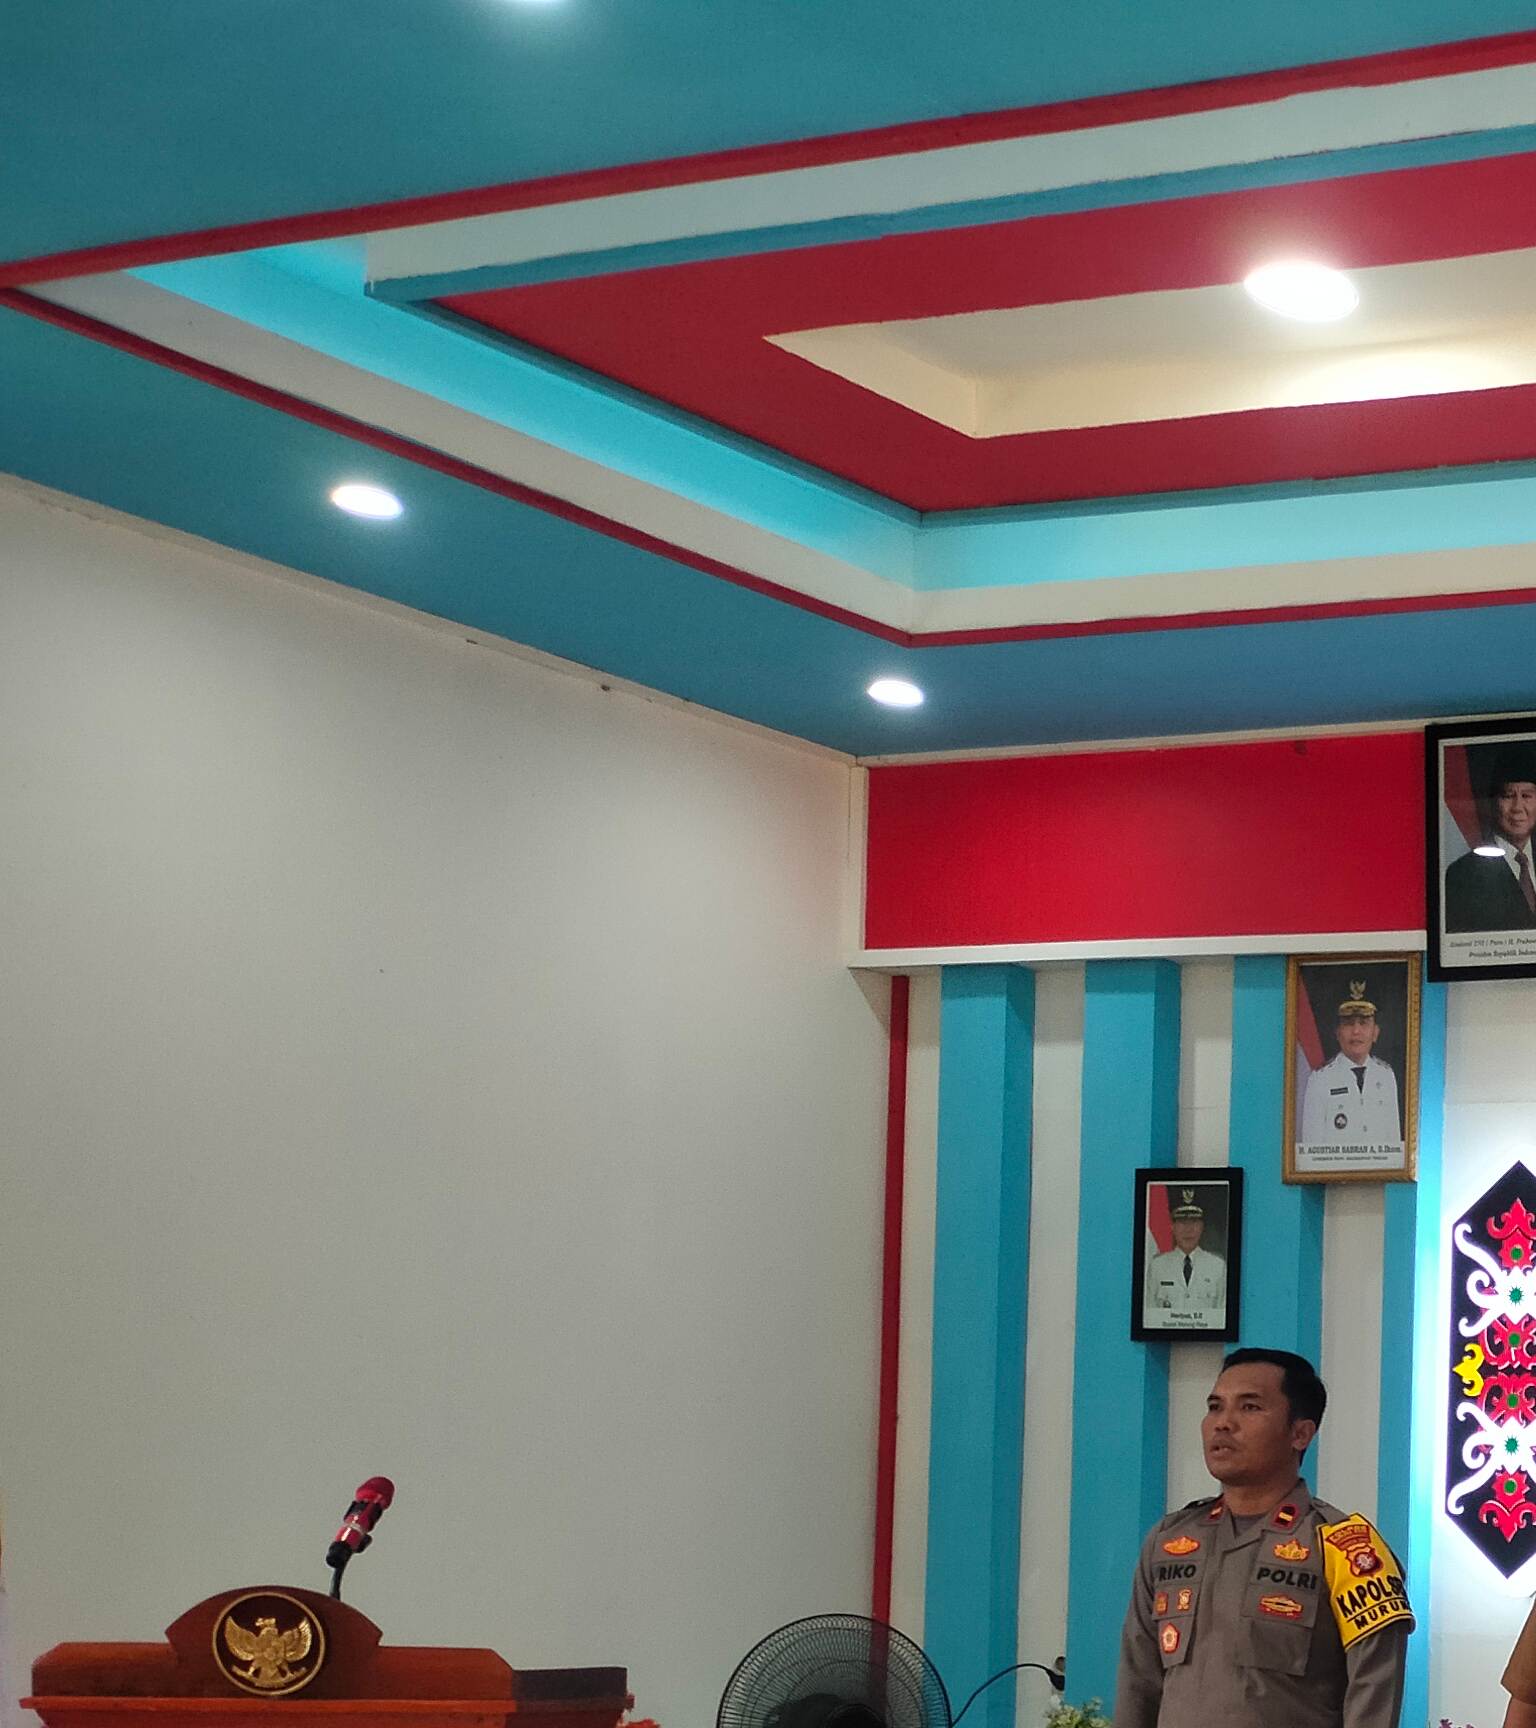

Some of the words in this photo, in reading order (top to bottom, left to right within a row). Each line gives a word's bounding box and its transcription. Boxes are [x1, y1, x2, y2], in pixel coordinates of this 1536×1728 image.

[1158, 1564, 1197, 1582] RIKO
[1256, 1566, 1318, 1590] POLRI
[1335, 1574, 1407, 1619] KAPOLS
